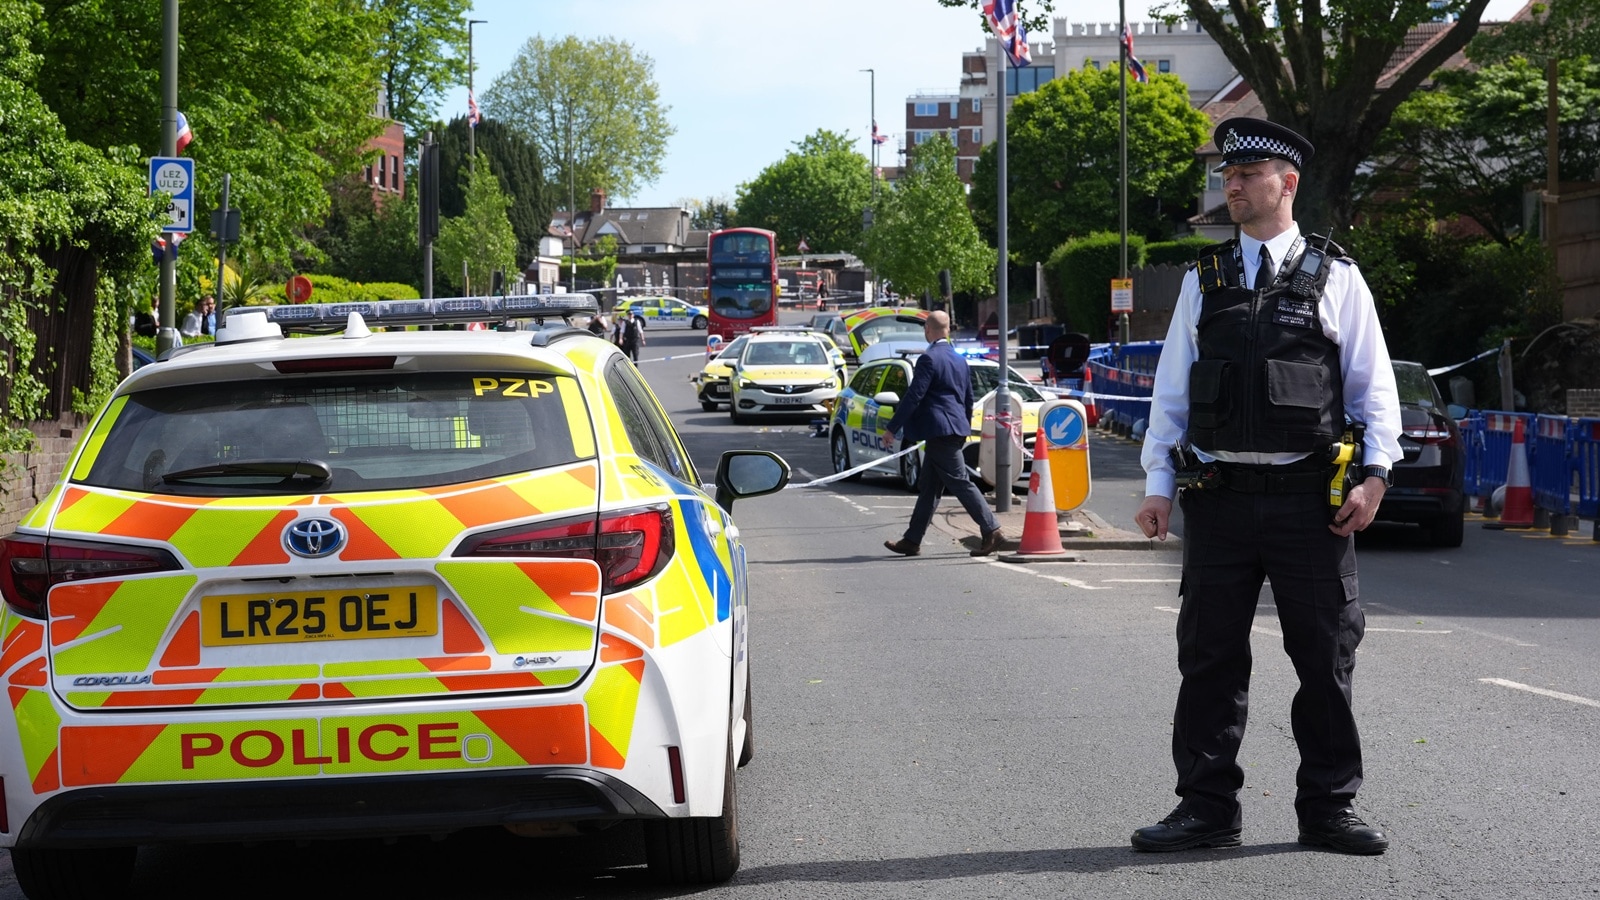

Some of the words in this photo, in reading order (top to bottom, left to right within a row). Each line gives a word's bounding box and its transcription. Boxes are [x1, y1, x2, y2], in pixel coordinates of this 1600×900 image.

[163, 170, 181, 178] LEZ
[159, 180, 185, 188] ULEZ
[473, 377, 554, 398] PZP
[220, 597, 326, 638] LR25
[339, 592, 417, 633] OEJ
[73, 674, 152, 686] COROLLA
[180, 722, 462, 769] POLICE
